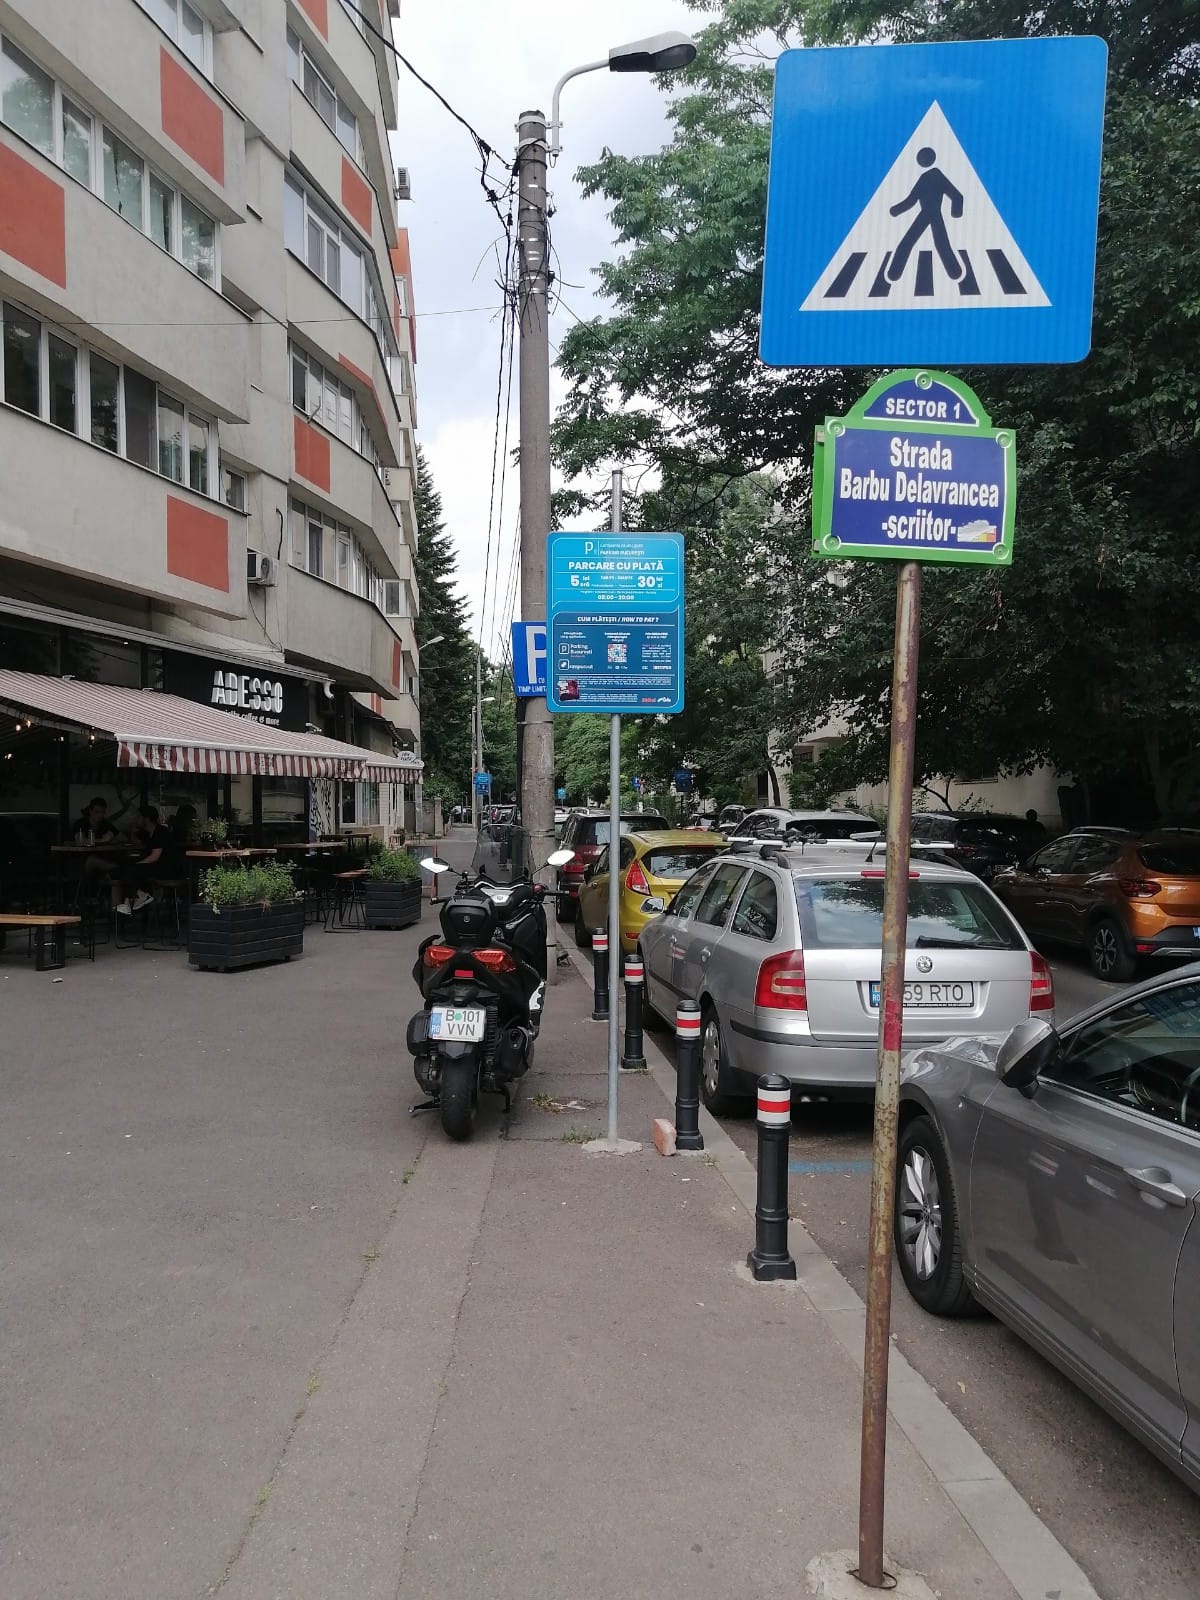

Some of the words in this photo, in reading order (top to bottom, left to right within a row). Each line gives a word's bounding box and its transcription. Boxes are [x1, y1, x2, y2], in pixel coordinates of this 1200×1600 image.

[886, 397, 947, 418] SECTOR
[954, 403, 961, 419] 1
[890, 437, 953, 471] Strada
[840, 468, 890, 502] Barbu
[895, 471, 999, 507] Delavrancea
[568, 561, 615, 570] PARCARE
[616, 562, 631, 570] CU
[632, 560, 664, 570] PLATĂ
[570, 574, 580, 587] 5
[637, 575, 655, 588] 30
[525, 626, 547, 684] P
[211, 670, 283, 713] ADESSO
[265, 717, 280, 726] more
[930, 984, 964, 1001] RTO
[445, 1010, 455, 1021] B
[462, 1011, 480, 1023] 101
[447, 1023, 475, 1036] VVN
